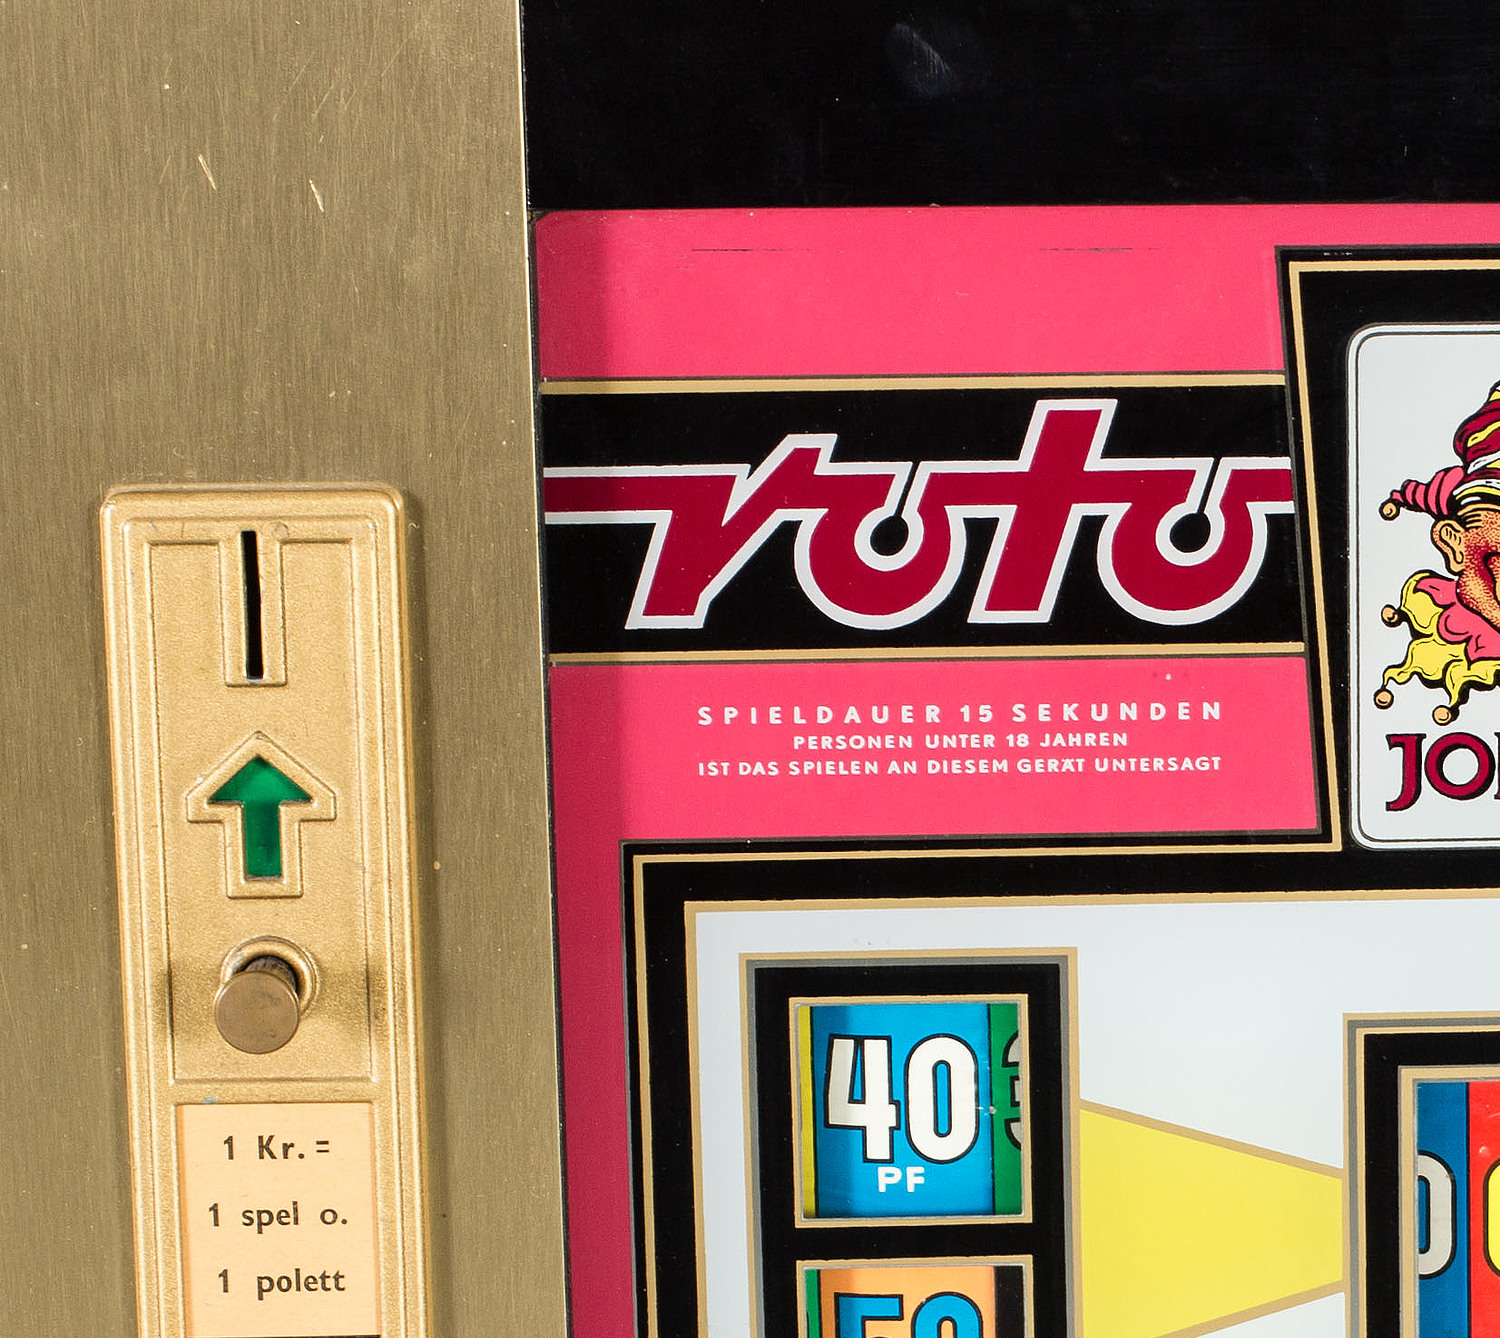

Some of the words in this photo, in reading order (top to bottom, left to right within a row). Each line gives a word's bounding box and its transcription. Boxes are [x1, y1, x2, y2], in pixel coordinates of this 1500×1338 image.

[697, 704, 941, 726] SPIELDAUER
[959, 704, 994, 723] 15
[1011, 701, 1221, 723] SEKUNDEN
[793, 734, 913, 750] PERSONEN
[925, 733, 996, 749] UNTER
[1005, 732, 1030, 748] 18
[1039, 732, 1128, 748] JAHREN
[698, 761, 731, 777] IST
[738, 761, 780, 777] DAS
[788, 760, 879, 776] SPIELEN
[886, 760, 918, 775] AN
[927, 758, 1009, 775] DIESEM
[1016, 757, 1086, 774] GERÄT
[1094, 756, 1222, 773] UNTERSAGT
[823, 1033, 979, 1164] 40
[223, 1135, 234, 1161] 1
[257, 1134, 305, 1160] Kr.
[877, 1166, 925, 1193] PF
[208, 1202, 220, 1227] 1
[241, 1200, 299, 1235] spel
[319, 1208, 348, 1226] o.
[218, 1268, 229, 1293] 1
[256, 1267, 346, 1301] polett
